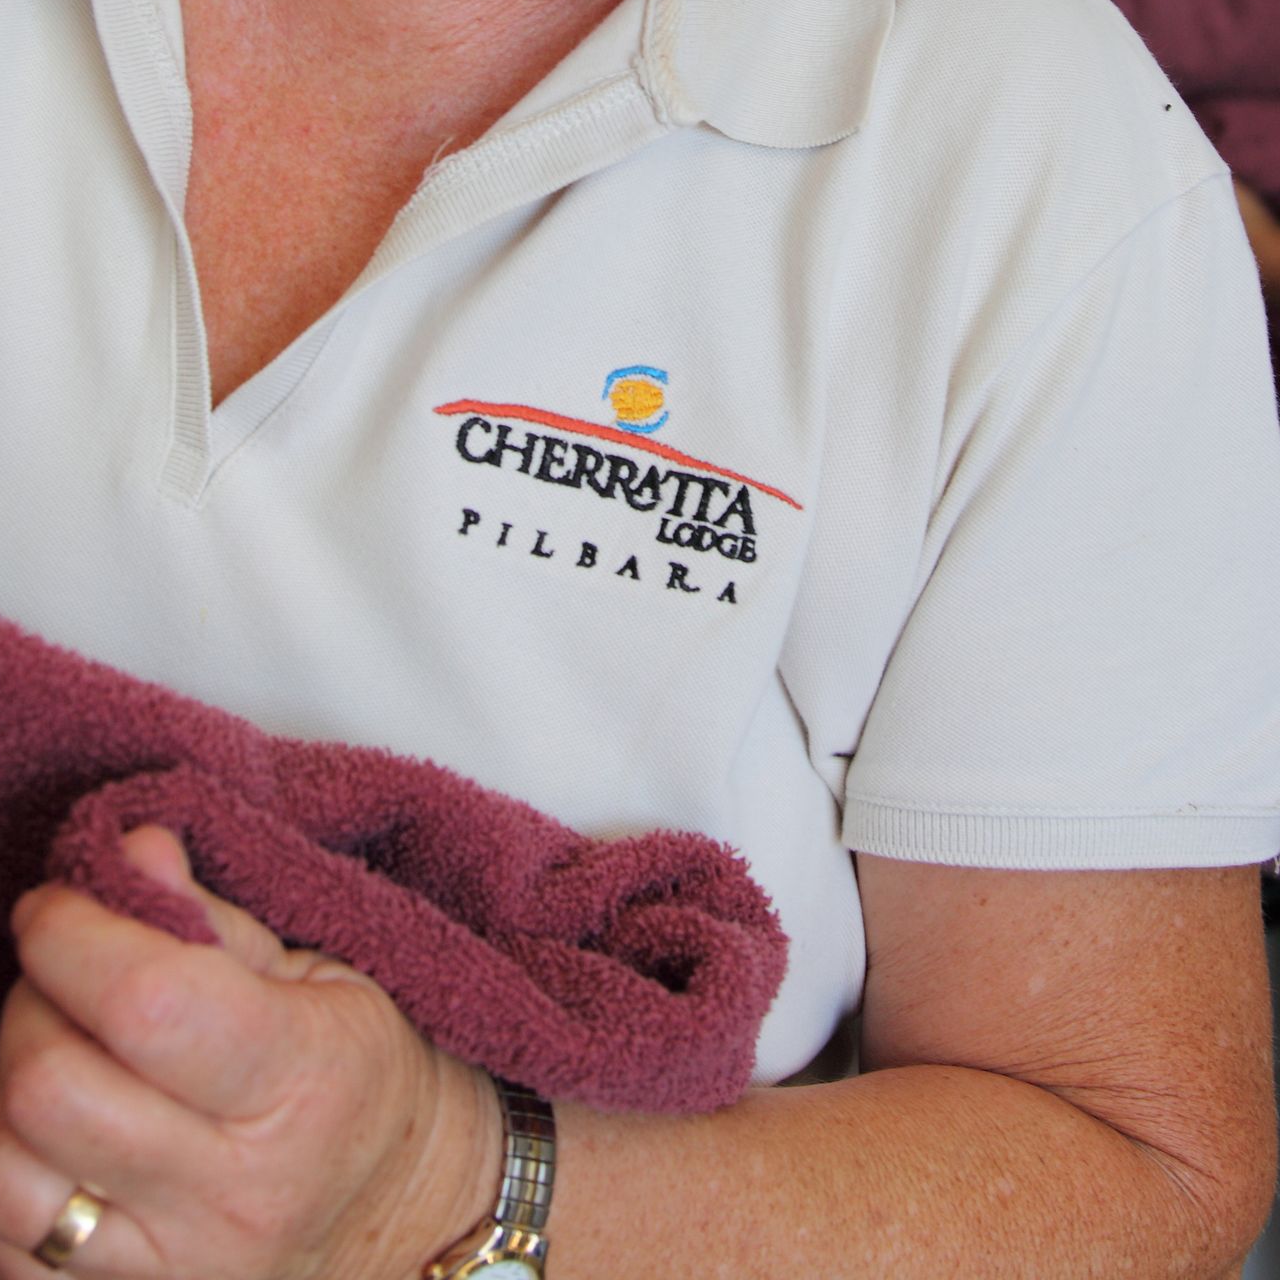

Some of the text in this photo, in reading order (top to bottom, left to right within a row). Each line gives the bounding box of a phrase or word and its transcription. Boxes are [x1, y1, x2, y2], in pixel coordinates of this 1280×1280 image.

[456, 417, 757, 535] CHERRATTA
[457, 508, 738, 604] PILBARA
[655, 517, 757, 563] LODGE
